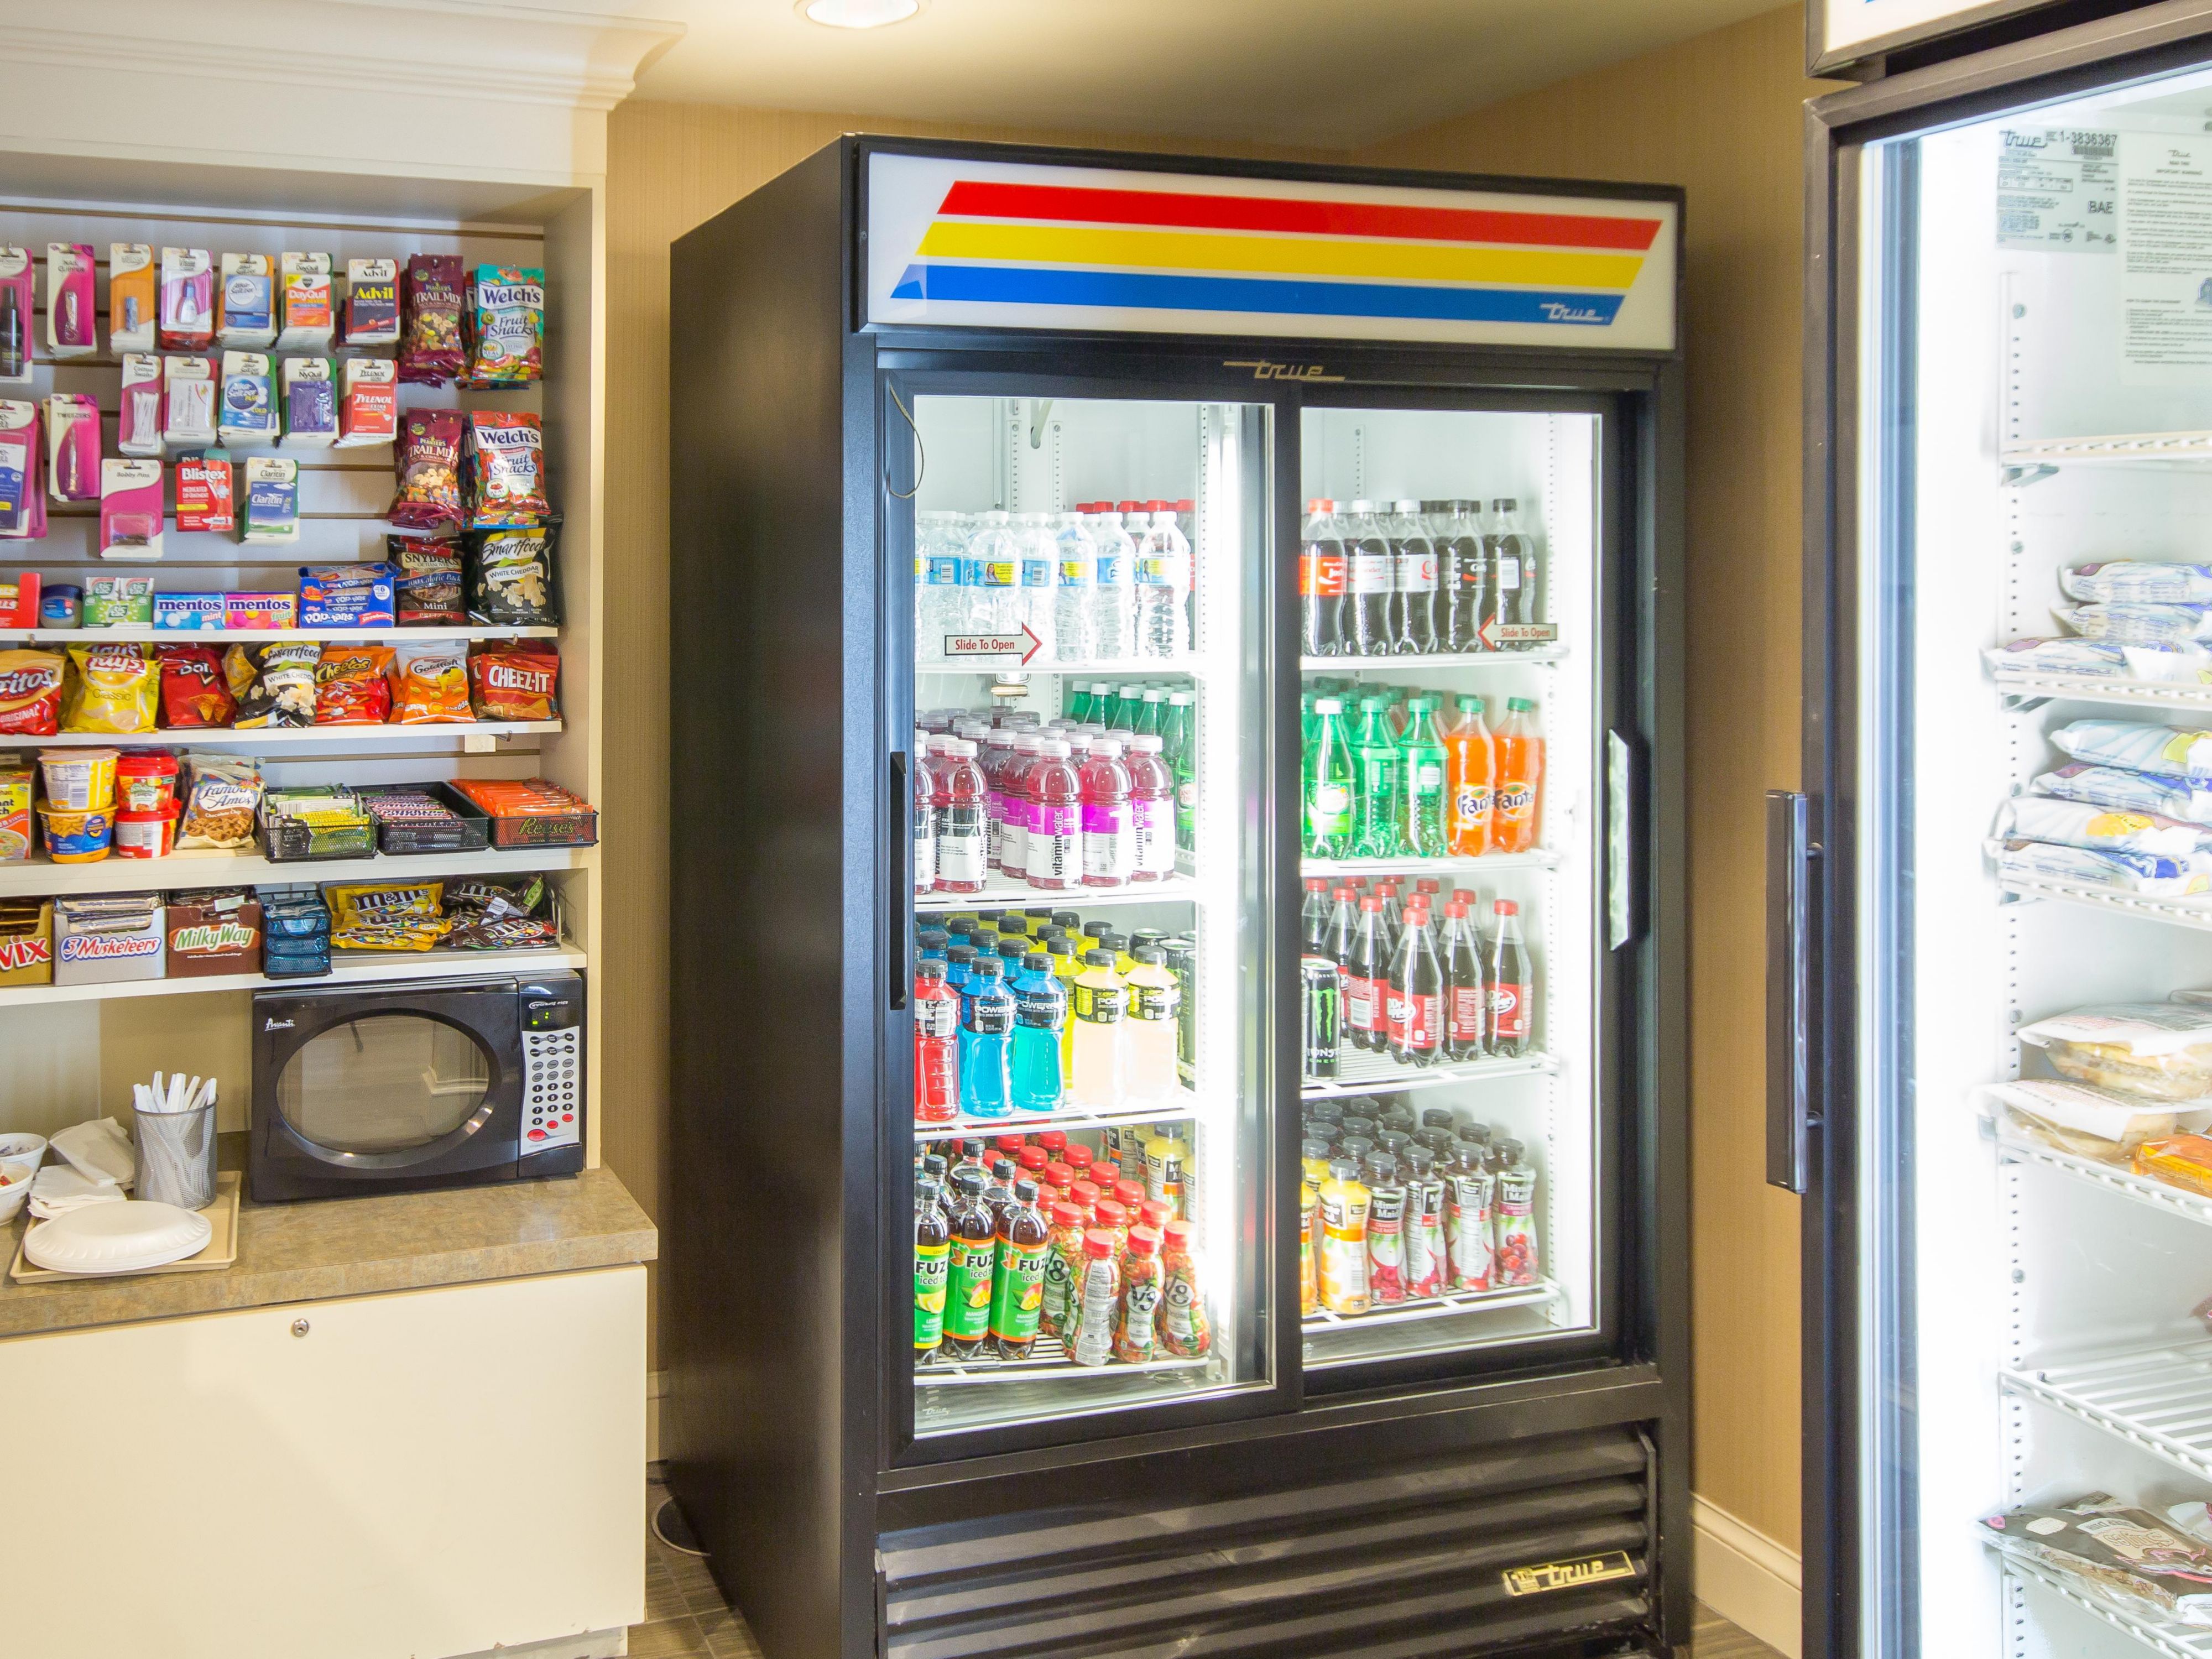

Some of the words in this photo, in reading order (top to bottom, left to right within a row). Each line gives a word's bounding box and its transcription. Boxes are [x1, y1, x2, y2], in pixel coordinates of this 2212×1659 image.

[2088, 201, 2114, 214] BAE
[361, 269, 387, 278] Advil
[289, 289, 327, 300] DayQuil
[354, 286, 394, 300] Advil
[416, 291, 440, 304] TRAIL
[444, 292, 462, 305] MIX
[482, 288, 540, 304] Welch's
[1539, 302, 1605, 322] true
[499, 315, 528, 326] Fruit
[490, 324, 534, 337] Snacks
[1223, 359, 1345, 381] true
[354, 393, 392, 405] TYLENOL
[479, 429, 540, 444] Welch's
[409, 445, 437, 458] TRAIL
[181, 467, 227, 483] Blistex
[259, 469, 285, 478] Claritin
[251, 493, 283, 505] Claritin
[482, 538, 545, 564] Smartfood
[489, 570, 510, 579] WHITE
[511, 565, 539, 576] CHEDDAR
[158, 599, 222, 611] mentos
[229, 598, 291, 611] mentos
[424, 602, 447, 610] Mini
[202, 612, 222, 622] mint
[271, 611, 292, 620] fruit
[1501, 628, 1519, 638] Slide
[1521, 628, 1529, 637] To
[1530, 628, 1551, 639] Open
[955, 639, 977, 650] Slide
[979, 639, 989, 650] To
[991, 639, 1015, 653] Open
[316, 656, 372, 683] Cheetos
[414, 659, 458, 674] Goldfish
[268, 672, 290, 683] WHITE
[489, 665, 550, 692] CHEEZ-IT
[92, 688, 132, 701] Classic
[207, 794, 252, 809] Amos
[1052, 810, 1063, 877] vitaminwater
[175, 927, 220, 950] Milky
[220, 923, 254, 947] Way
[63, 939, 79, 954] 3
[77, 937, 158, 957] Musketeers
[264, 1018, 295, 1031] Avanti
[967, 1253, 994, 1268] FUZ
[1019, 1258, 1046, 1272] FUZ
[916, 1261, 947, 1275] FUZ
[971, 1269, 988, 1278] iced
[920, 1275, 938, 1284] iced
[1022, 1272, 1040, 1281] iced
[1536, 1560, 1626, 1586] true
